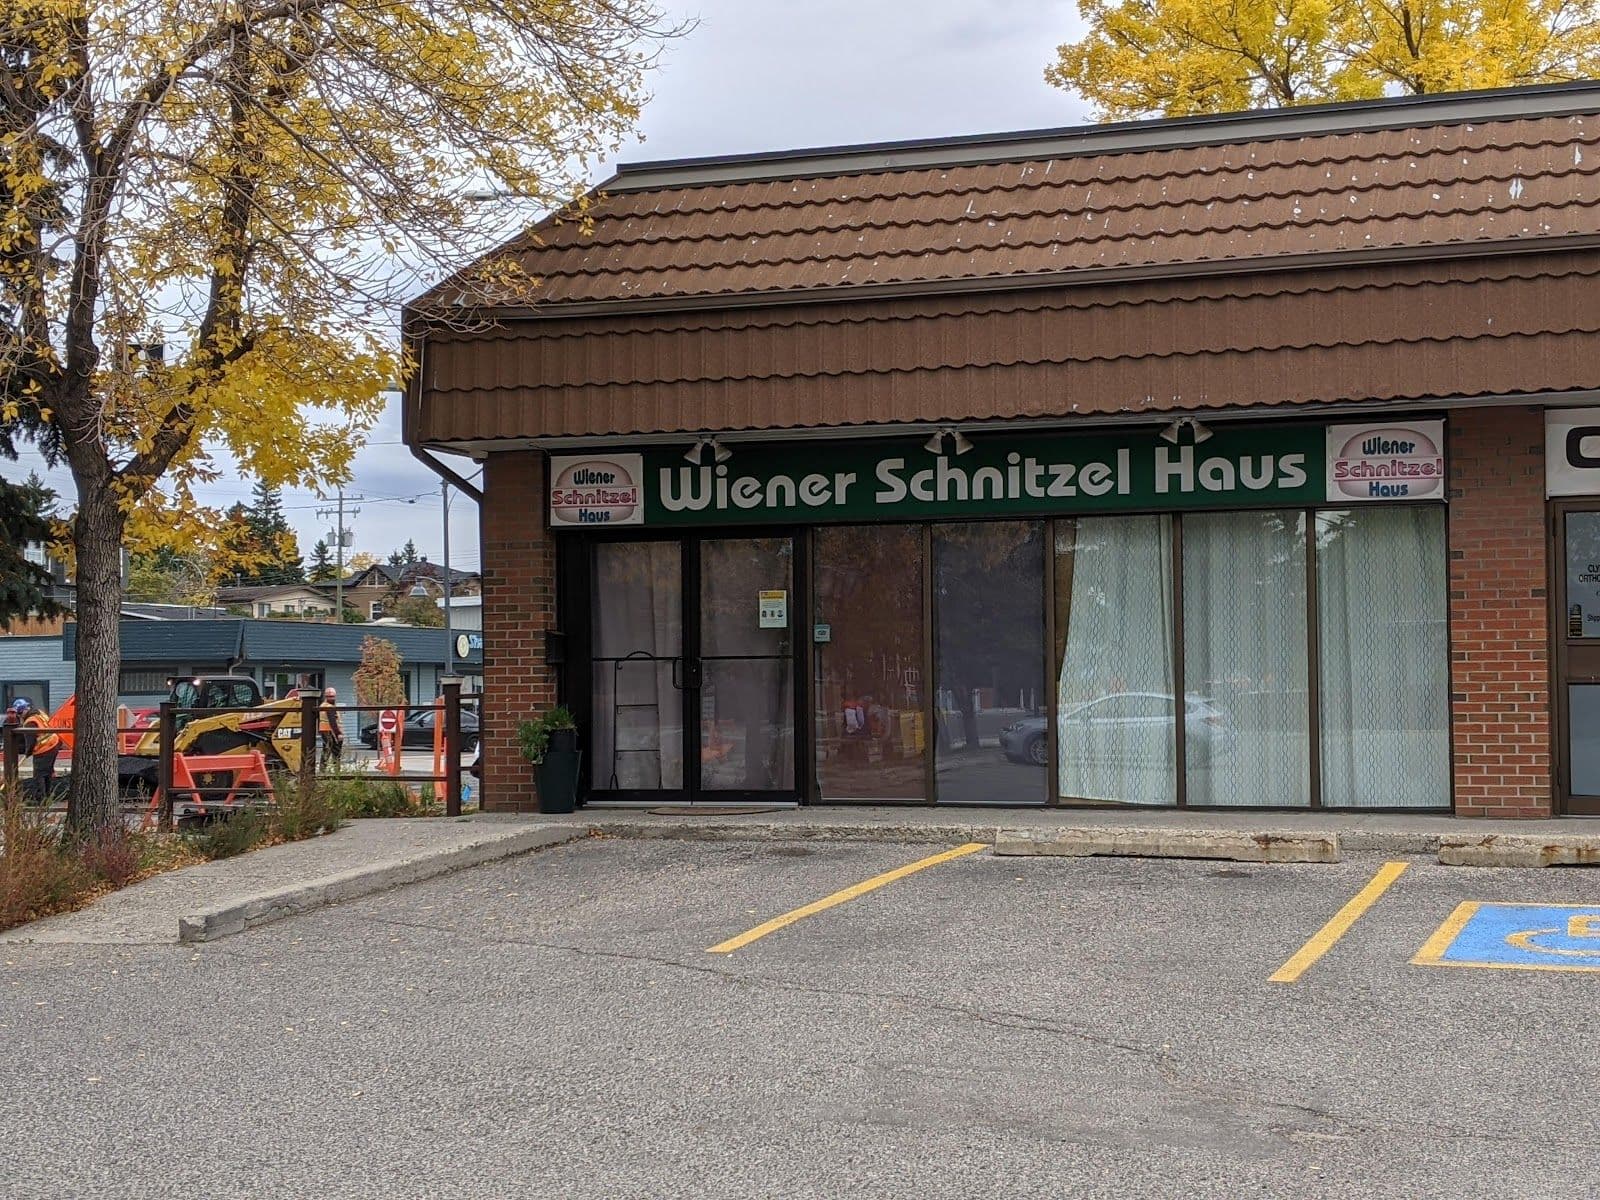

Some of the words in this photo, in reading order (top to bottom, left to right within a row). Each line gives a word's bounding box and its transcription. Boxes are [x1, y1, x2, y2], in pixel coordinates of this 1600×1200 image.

[1362, 436, 1416, 455] Wiener
[573, 468, 616, 485] Wiener
[1335, 458, 1442, 478] Schnitzel
[659, 464, 857, 512] Wiener
[875, 450, 1130, 504] Schnitzel
[1155, 445, 1307, 494] Haus
[552, 488, 637, 505] Schnitzel
[1369, 481, 1409, 497] Haus
[578, 508, 610, 523] Haus
[277, 728, 292, 739] CAT
